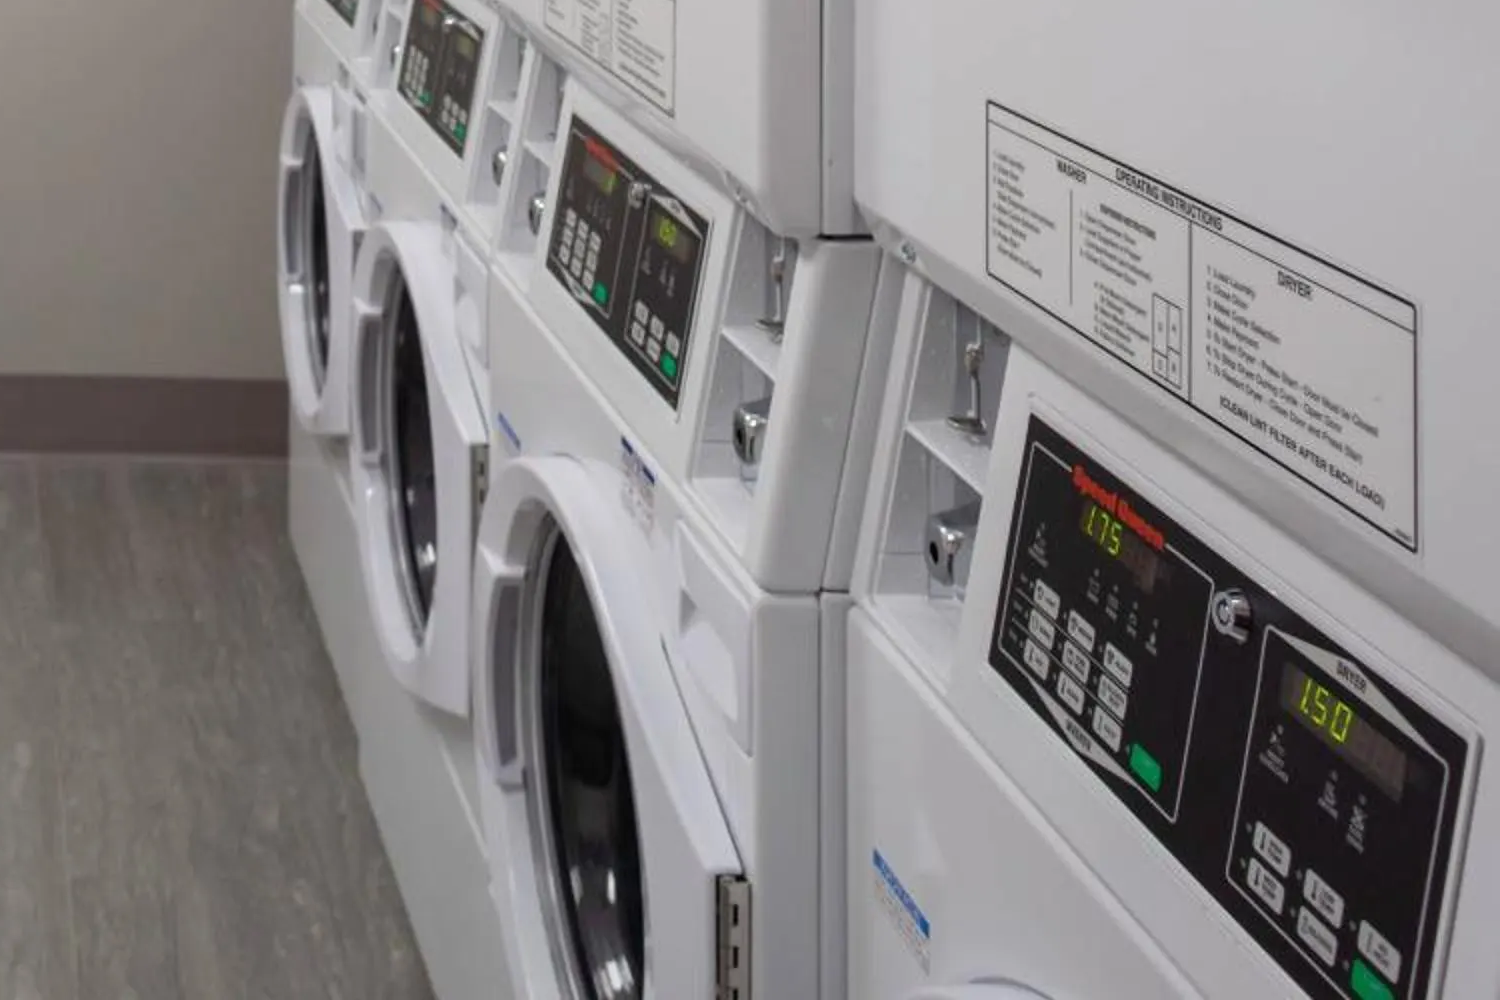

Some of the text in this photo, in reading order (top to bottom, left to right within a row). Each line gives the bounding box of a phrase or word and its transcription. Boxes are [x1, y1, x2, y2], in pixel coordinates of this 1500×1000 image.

[1056, 159, 1088, 184] WASHER
[1115, 167, 1160, 200] OPERATING
[1161, 189, 1223, 231] INSTRUCTIONS
[1277, 270, 1314, 301] DRYER
[1269, 426, 1296, 451] FILTER
[1298, 445, 1326, 470] AFTER
[1329, 463, 1353, 490] EACH
